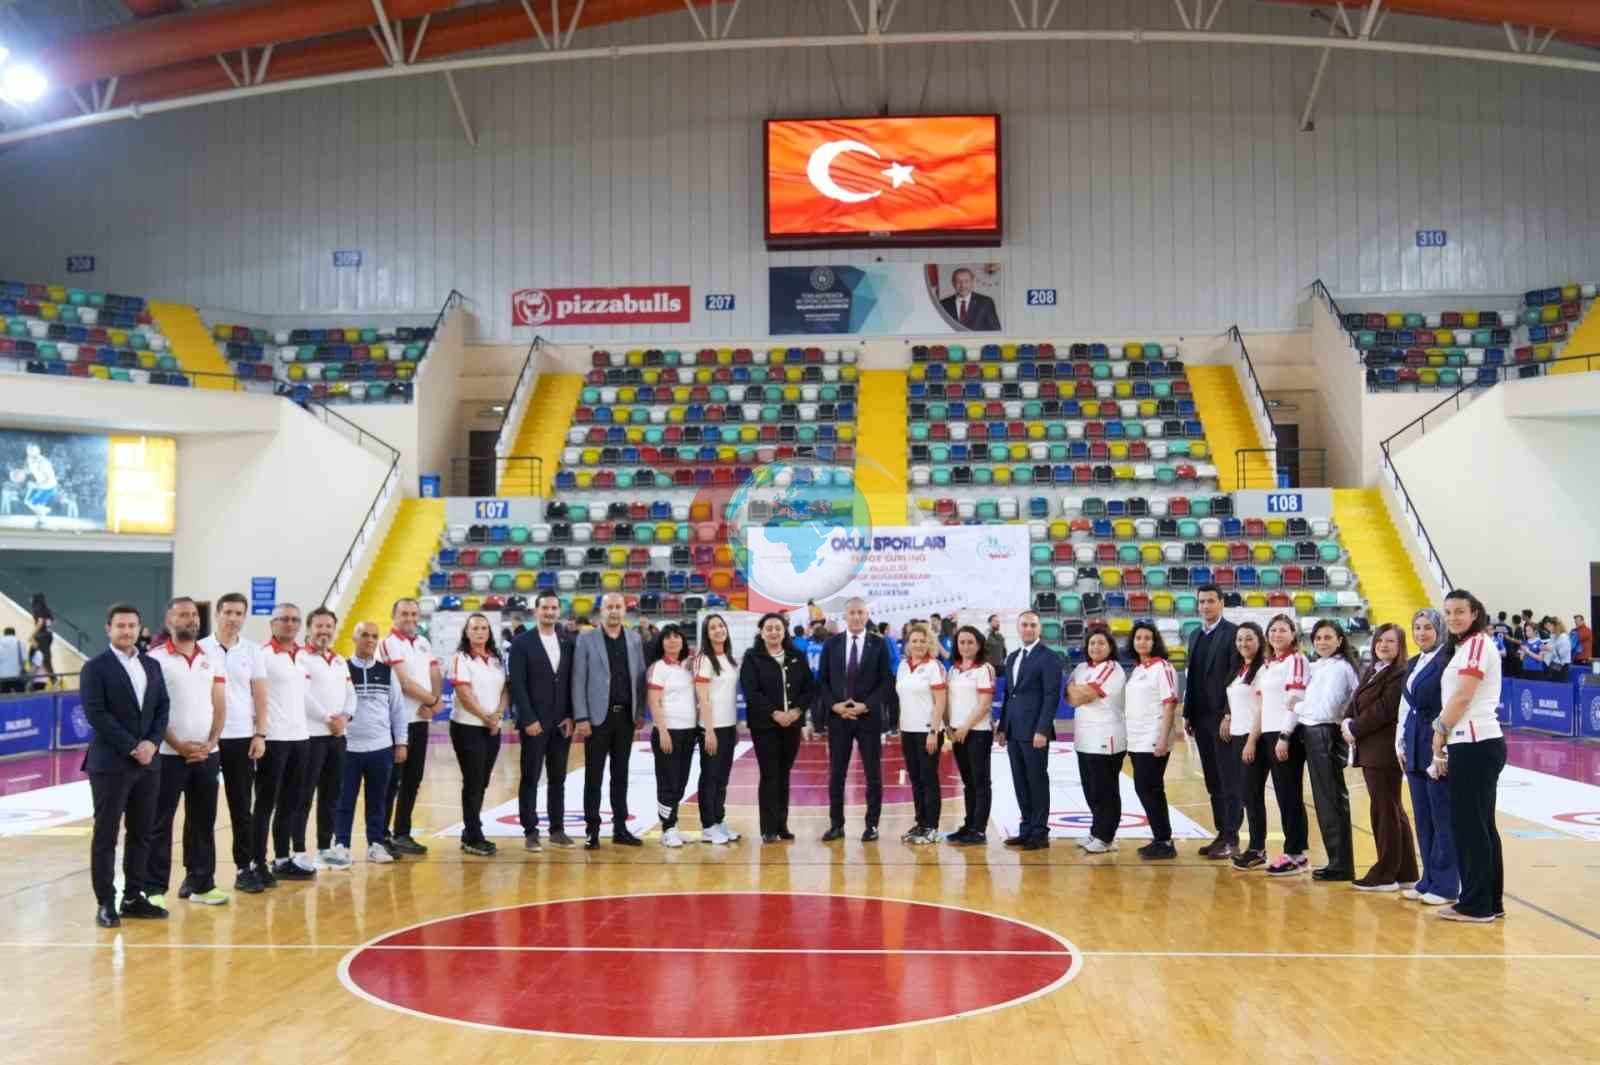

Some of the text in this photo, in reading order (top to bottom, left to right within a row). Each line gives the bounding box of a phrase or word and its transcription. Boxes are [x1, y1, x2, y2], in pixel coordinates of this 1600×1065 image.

[1418, 230, 1444, 246] 310
[556, 291, 682, 319] pizzabulls
[708, 294, 732, 310] 207
[1030, 289, 1054, 305] 208
[477, 501, 505, 518] 107
[1269, 494, 1298, 512] 108
[831, 534, 946, 551] OKUL SPORLARI
